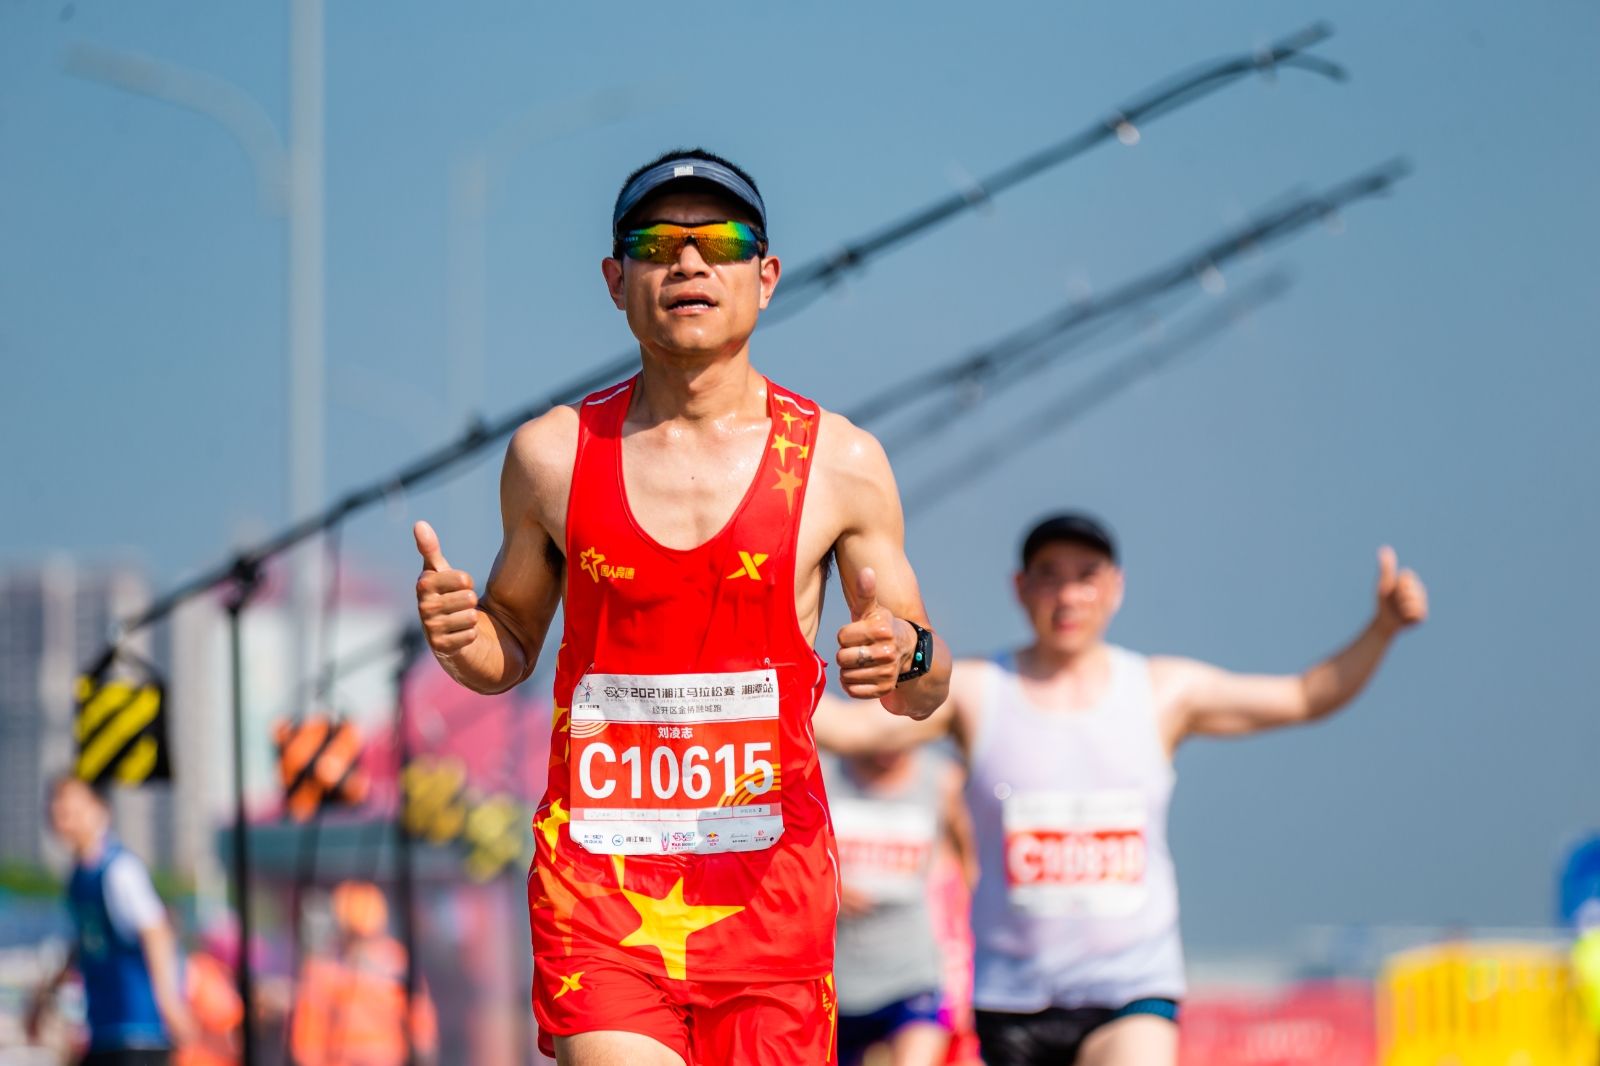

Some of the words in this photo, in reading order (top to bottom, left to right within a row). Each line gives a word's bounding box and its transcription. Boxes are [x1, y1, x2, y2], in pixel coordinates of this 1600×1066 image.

[631, 686, 736, 698] 2021湘江马拉松赛
[741, 683, 774, 695] 湘潭站
[657, 726, 693, 739] 刘凌志
[579, 742, 774, 800] C10615
